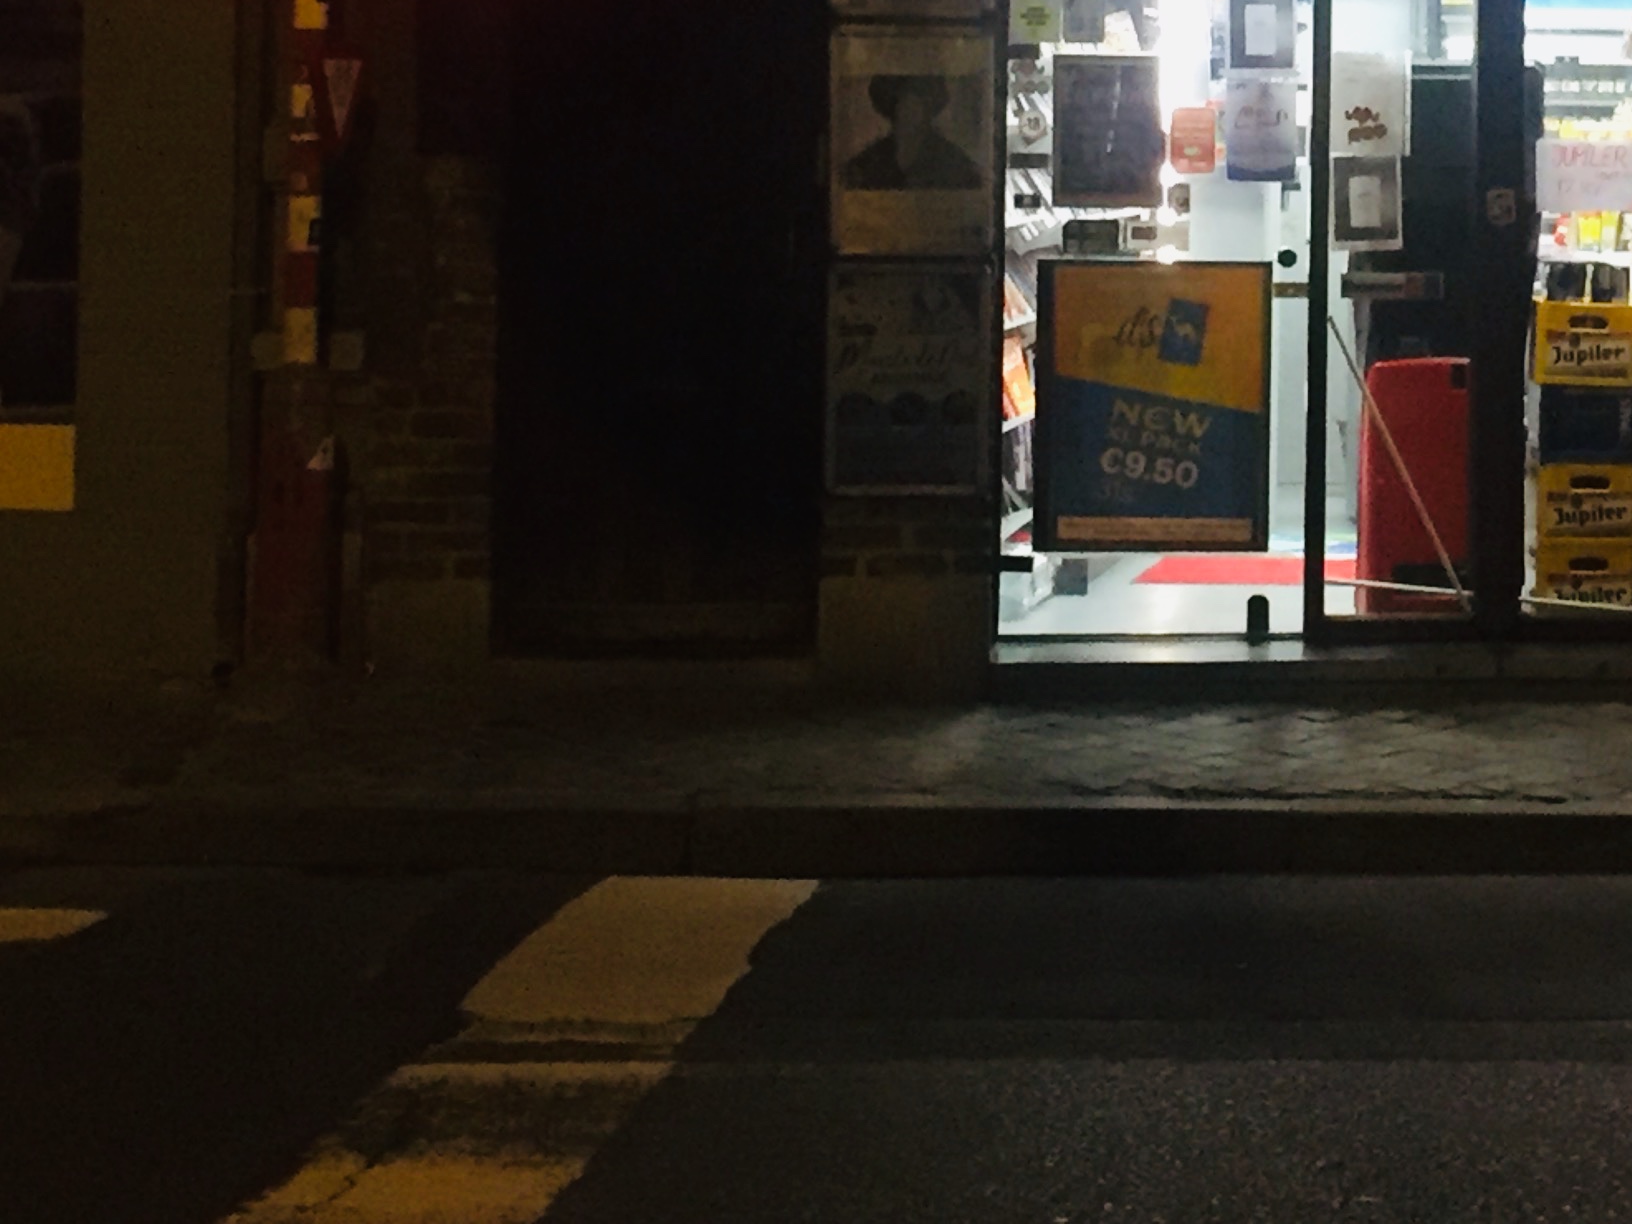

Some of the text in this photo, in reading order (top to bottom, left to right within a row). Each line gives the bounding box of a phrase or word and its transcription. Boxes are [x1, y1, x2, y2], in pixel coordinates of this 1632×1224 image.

[1551, 343, 1627, 367] Jupiler
[1110, 398, 1214, 438] NEW
[1099, 447, 1200, 490] €9.50
[1552, 501, 1629, 527] Jupiler
